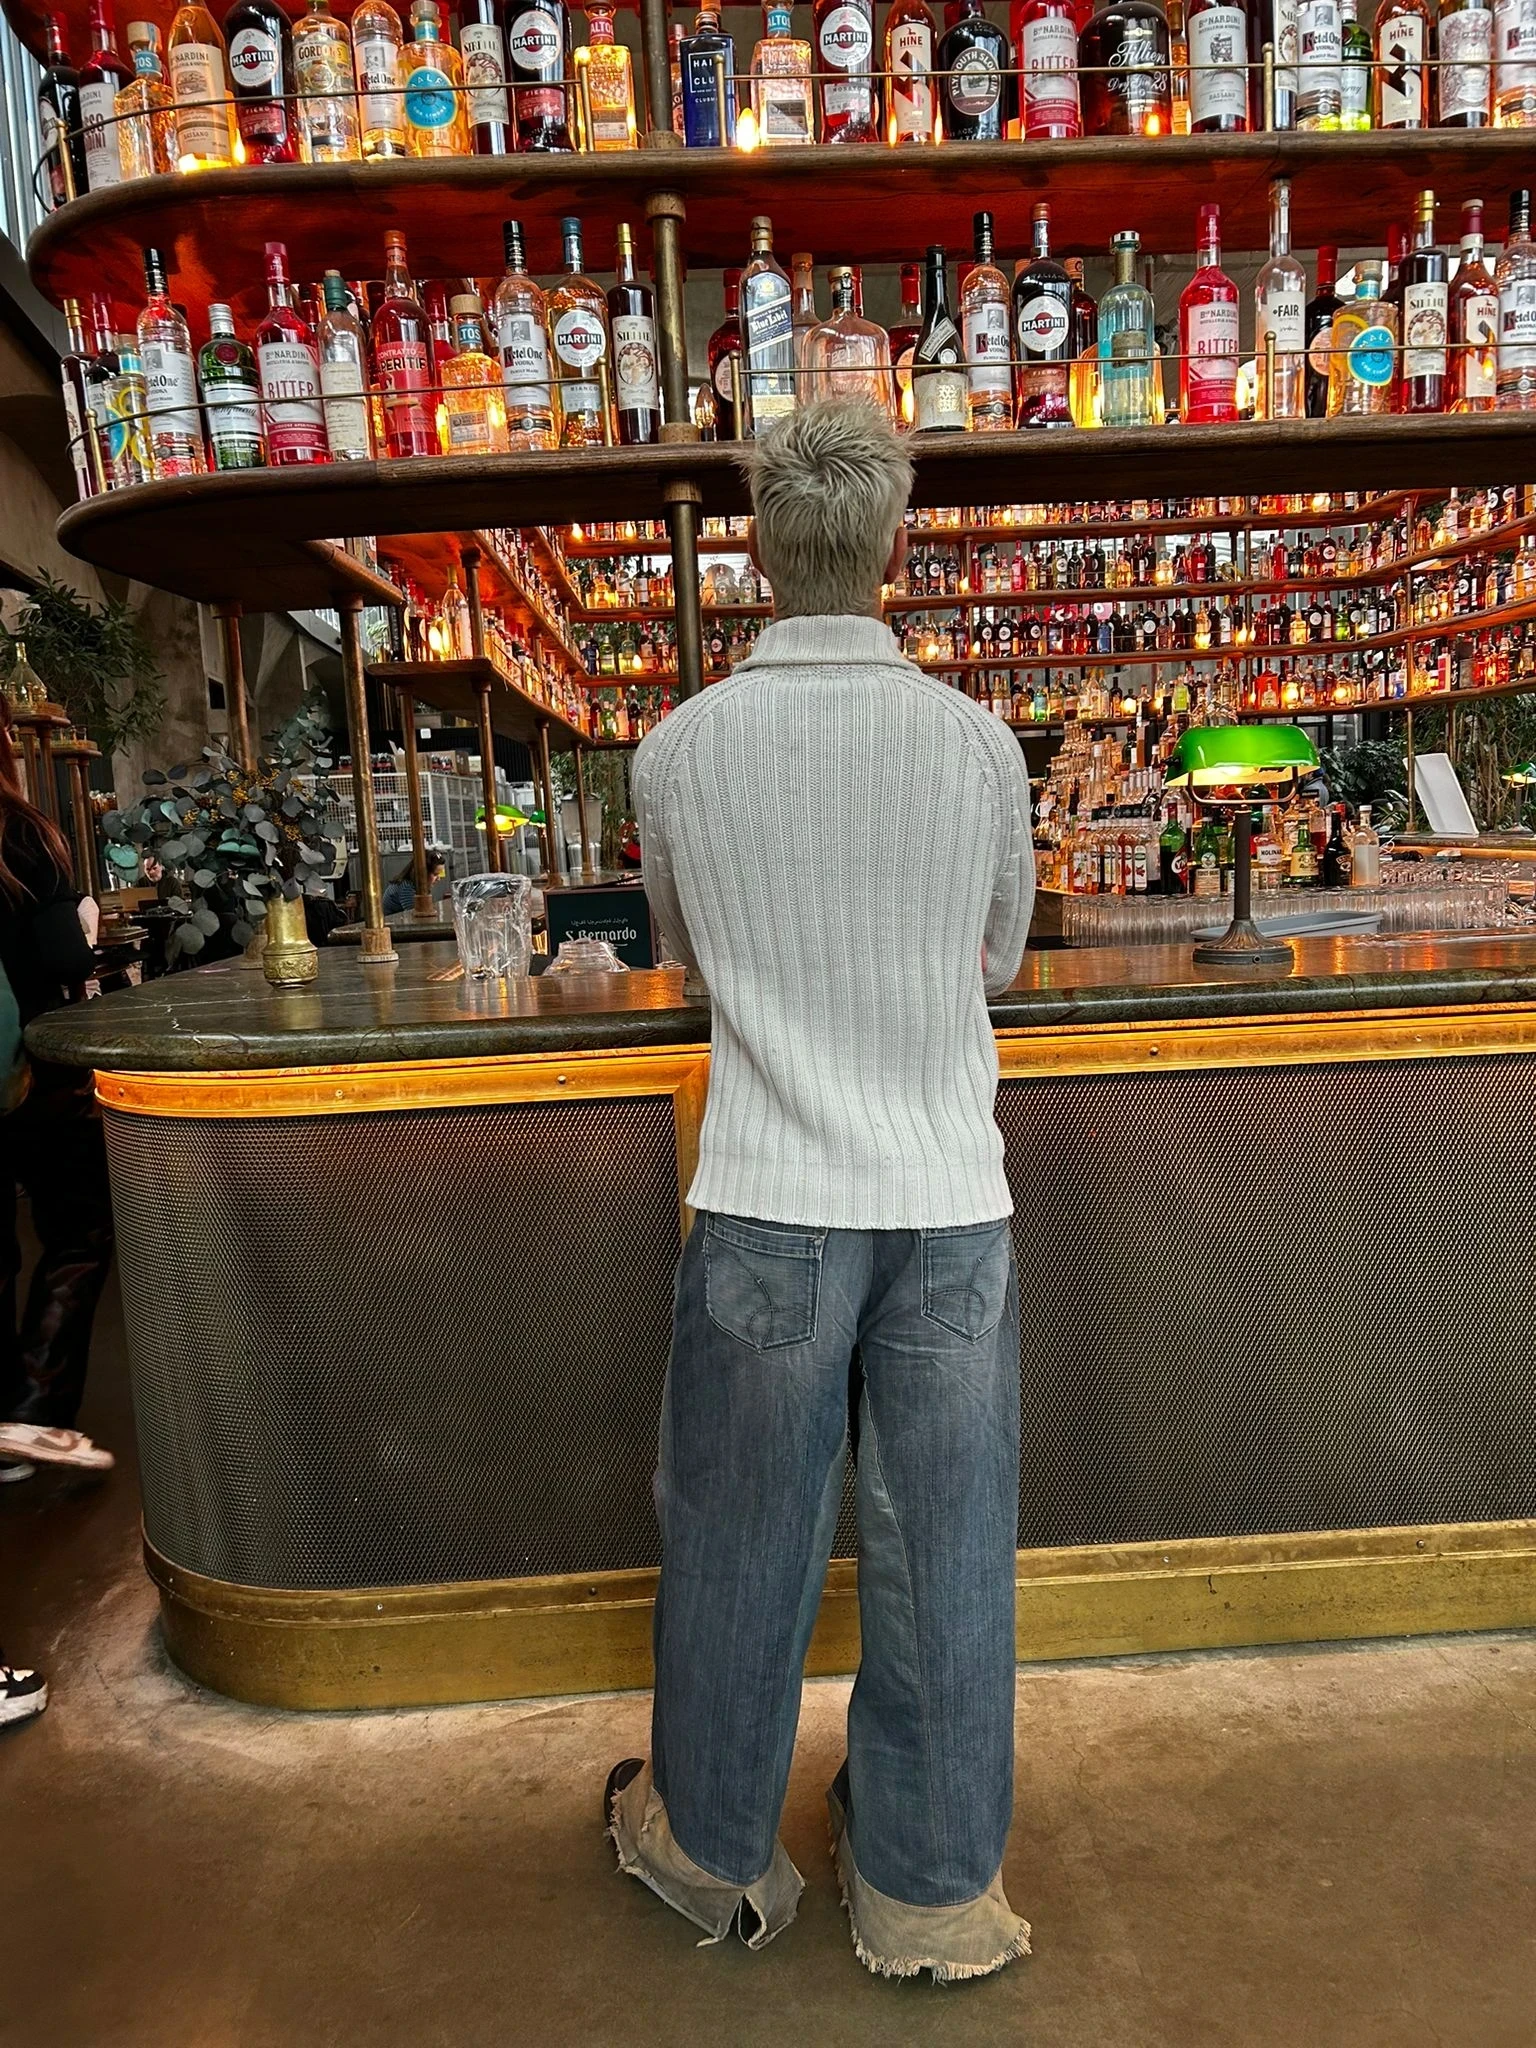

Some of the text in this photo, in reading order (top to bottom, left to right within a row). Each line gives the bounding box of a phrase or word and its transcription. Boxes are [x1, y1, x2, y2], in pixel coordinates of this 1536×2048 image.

[1208, 15, 1241, 25] NARDINI
[825, 33, 868, 45] MARTINI
[1389, 28, 1414, 40] HINE
[513, 35, 556, 49] MARTINI
[900, 36, 923, 47] HINE
[232, 51, 273, 67] MARTINI
[693, 58, 713, 68] HAI
[951, 50, 978, 96] PLYOUTH
[381, 75, 396, 86] One
[693, 76, 716, 85] CLU
[1151, 71, 1167, 92] 28
[1278, 304, 1300, 317] FAIR
[1022, 317, 1065, 332] MARTINI
[459, 329, 482, 340] TOS
[559, 333, 602, 346] MARTINI
[976, 332, 1000, 354] Ketel
[274, 349, 309, 360] NARDINI
[503, 346, 543, 368] Ketel One
[268, 380, 314, 399] BITTER
[1261, 848, 1282, 856] MOLINA
